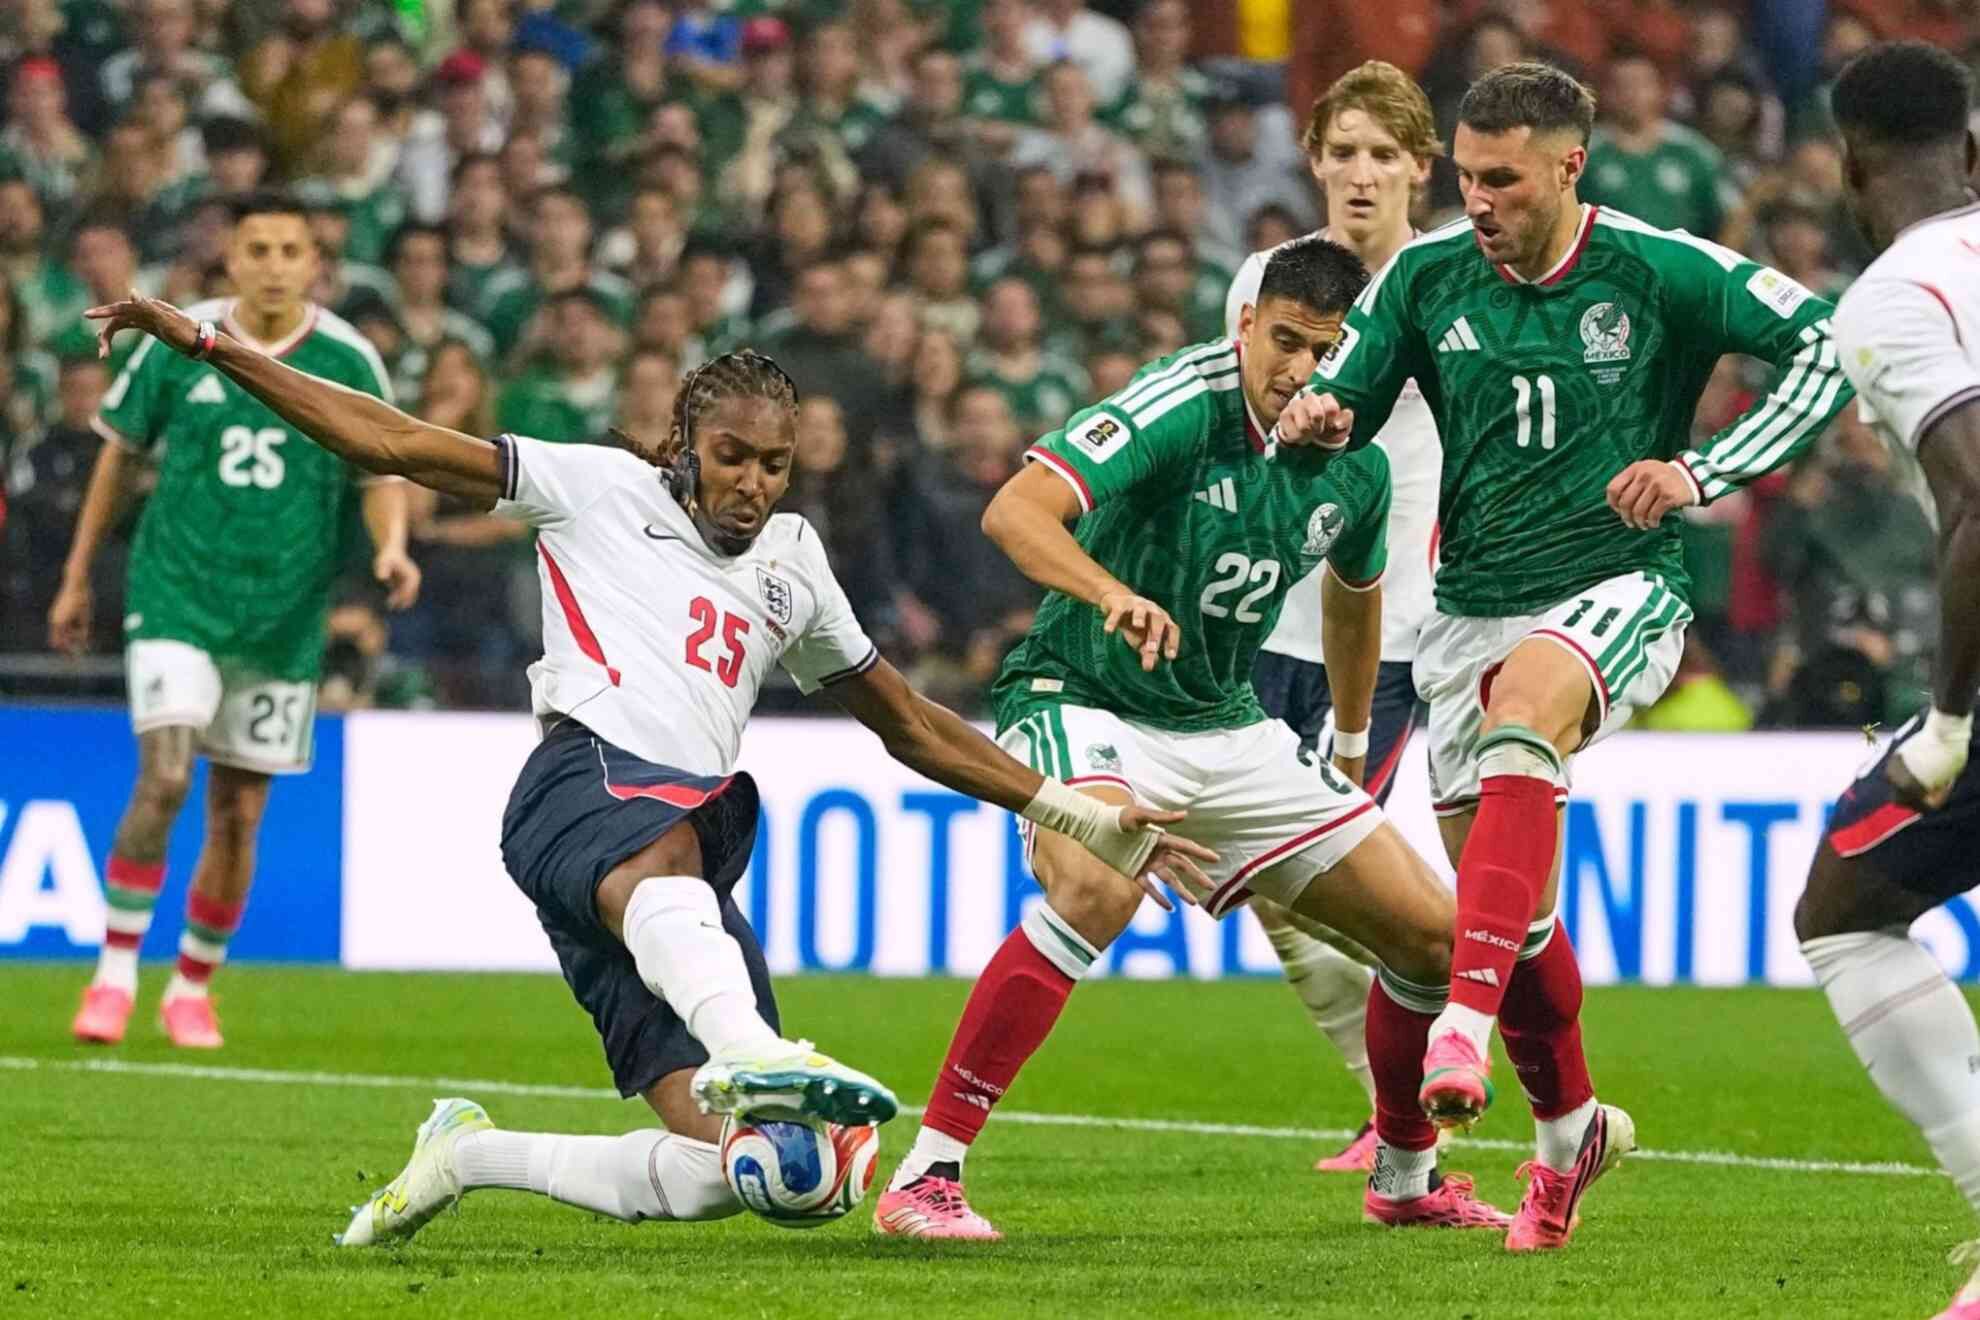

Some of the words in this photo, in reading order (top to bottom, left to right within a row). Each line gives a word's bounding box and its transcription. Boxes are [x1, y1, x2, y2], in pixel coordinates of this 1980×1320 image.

[1511, 374, 1556, 449] 11
[219, 424, 287, 489] 25
[1201, 551, 1280, 623] 22
[1562, 599, 1622, 637] 11
[685, 595, 751, 689] 25
[0, 798, 107, 945] A
